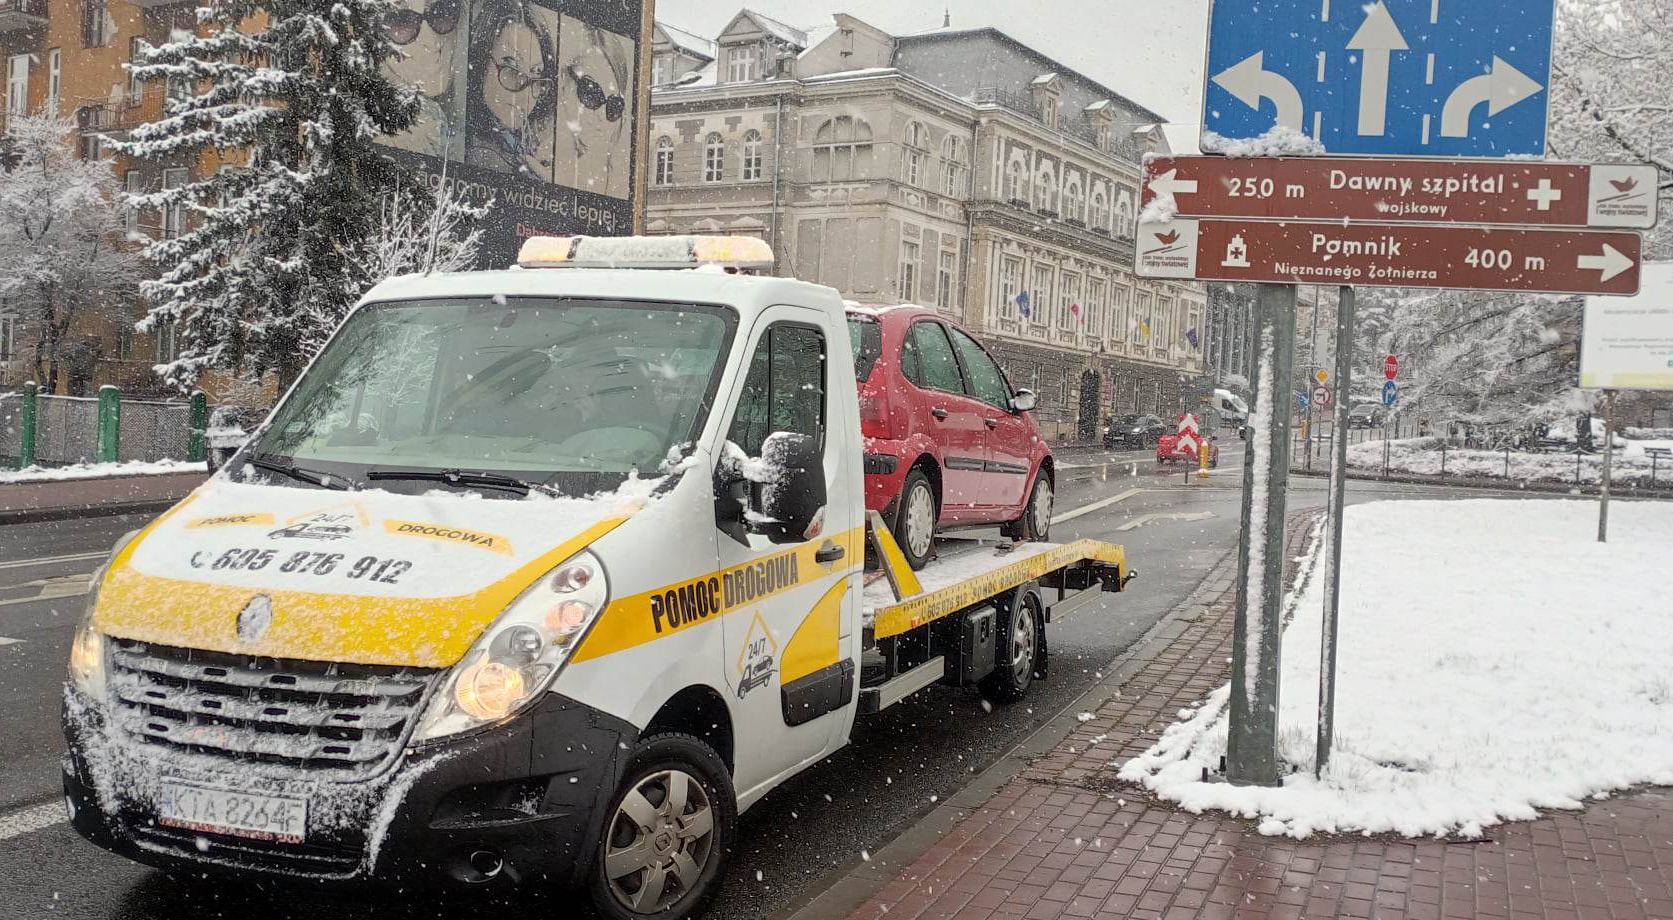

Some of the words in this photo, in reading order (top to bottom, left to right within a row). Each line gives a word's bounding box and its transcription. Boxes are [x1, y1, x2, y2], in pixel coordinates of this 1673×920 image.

[1228, 177, 1274, 197] 250
[1285, 184, 1305, 198] m
[1330, 170, 1412, 197] Dawny
[1421, 173, 1504, 198] szpital
[503, 187, 568, 216] widzieć
[574, 195, 616, 232] lepiej
[1378, 202, 1448, 217] wojskowy
[1312, 233, 1401, 256] Pomnik
[1465, 248, 1512, 269] 400
[1525, 256, 1545, 270] m
[1274, 262, 1362, 280] Nieznanego
[1368, 261, 1437, 279] Żołnierza
[397, 524, 494, 546] DROGOWA
[211, 548, 278, 571] 605
[280, 553, 345, 575] 876
[346, 556, 413, 584] 912
[651, 577, 720, 633] POMOC
[723, 552, 799, 609] DROGOWA
[748, 637, 766, 659] 24/7
[174, 787, 216, 822] KTA
[226, 797, 303, 832] 8264F
